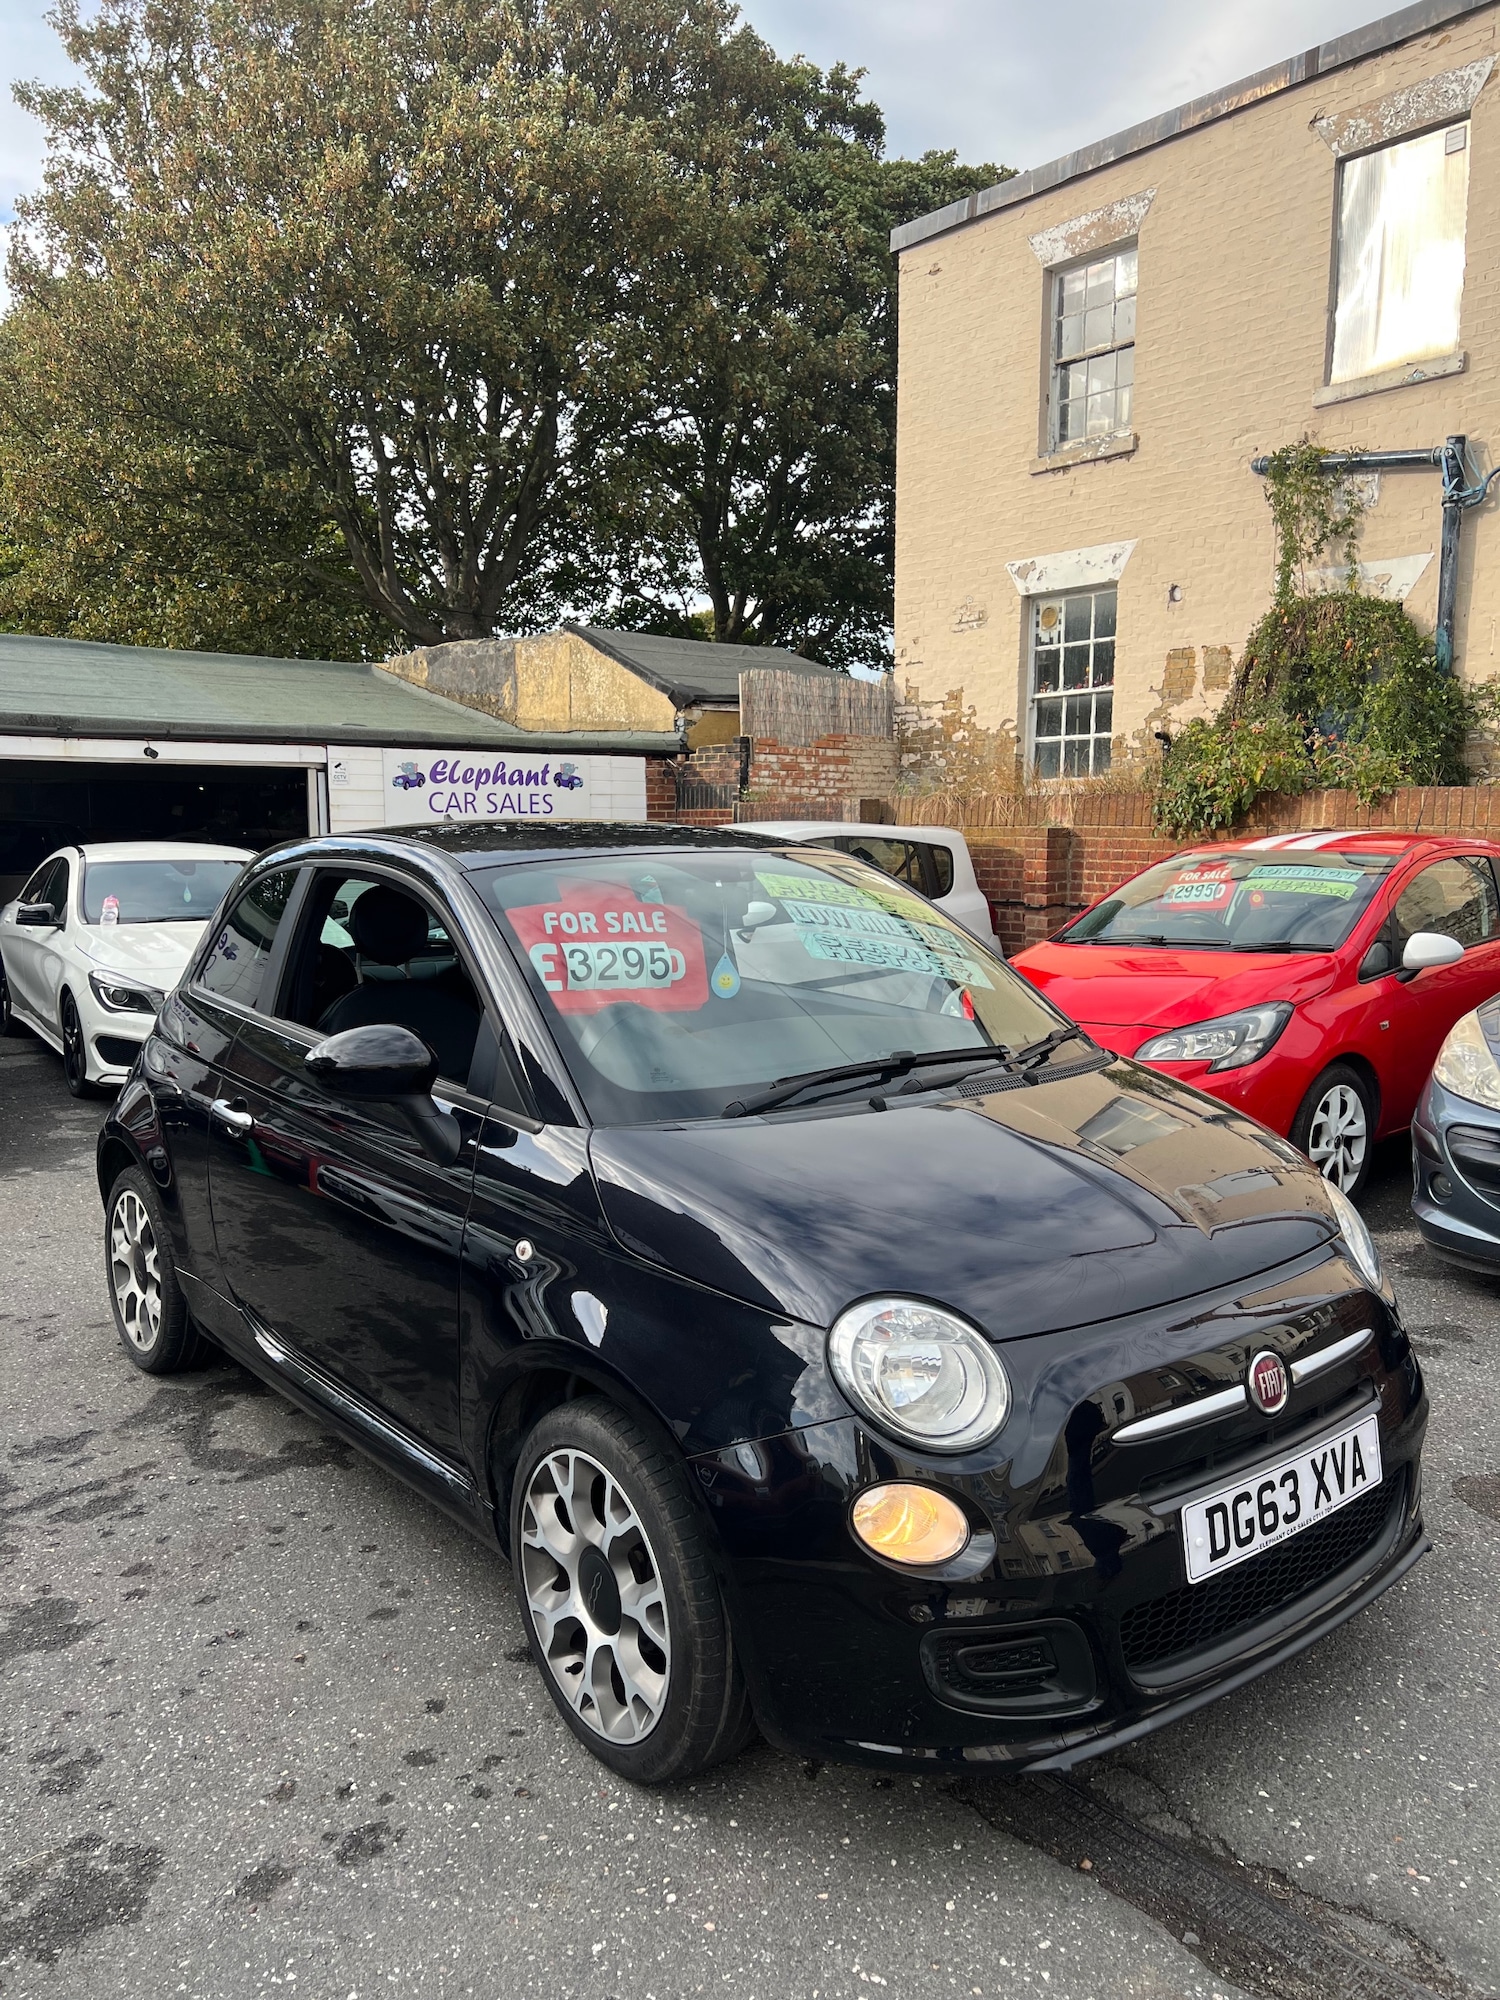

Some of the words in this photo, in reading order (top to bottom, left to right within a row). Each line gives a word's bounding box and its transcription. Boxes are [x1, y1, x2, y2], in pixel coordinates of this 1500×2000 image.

[429, 759, 550, 791] Elephant
[429, 791, 477, 814] CAR
[486, 793, 553, 814] SALES
[1178, 872, 1200, 881] FOR
[1201, 868, 1231, 880] SALE
[1254, 867, 1302, 876] LONG
[778, 885, 864, 907] FIRST
[543, 911, 600, 935] FOR
[603, 911, 668, 934] SALE
[790, 903, 852, 929] LOW
[813, 932, 970, 971] SERVICE
[821, 945, 974, 982] HISTORY
[1258, 1367, 1280, 1400] FIAT
[1205, 1469, 1301, 1563] DG63
[1310, 1434, 1367, 1510] XVA
[1259, 1532, 1285, 1549] ELEPHANT
[1286, 1527, 1297, 1535] CAR
[1297, 1517, 1312, 1529] SALES
